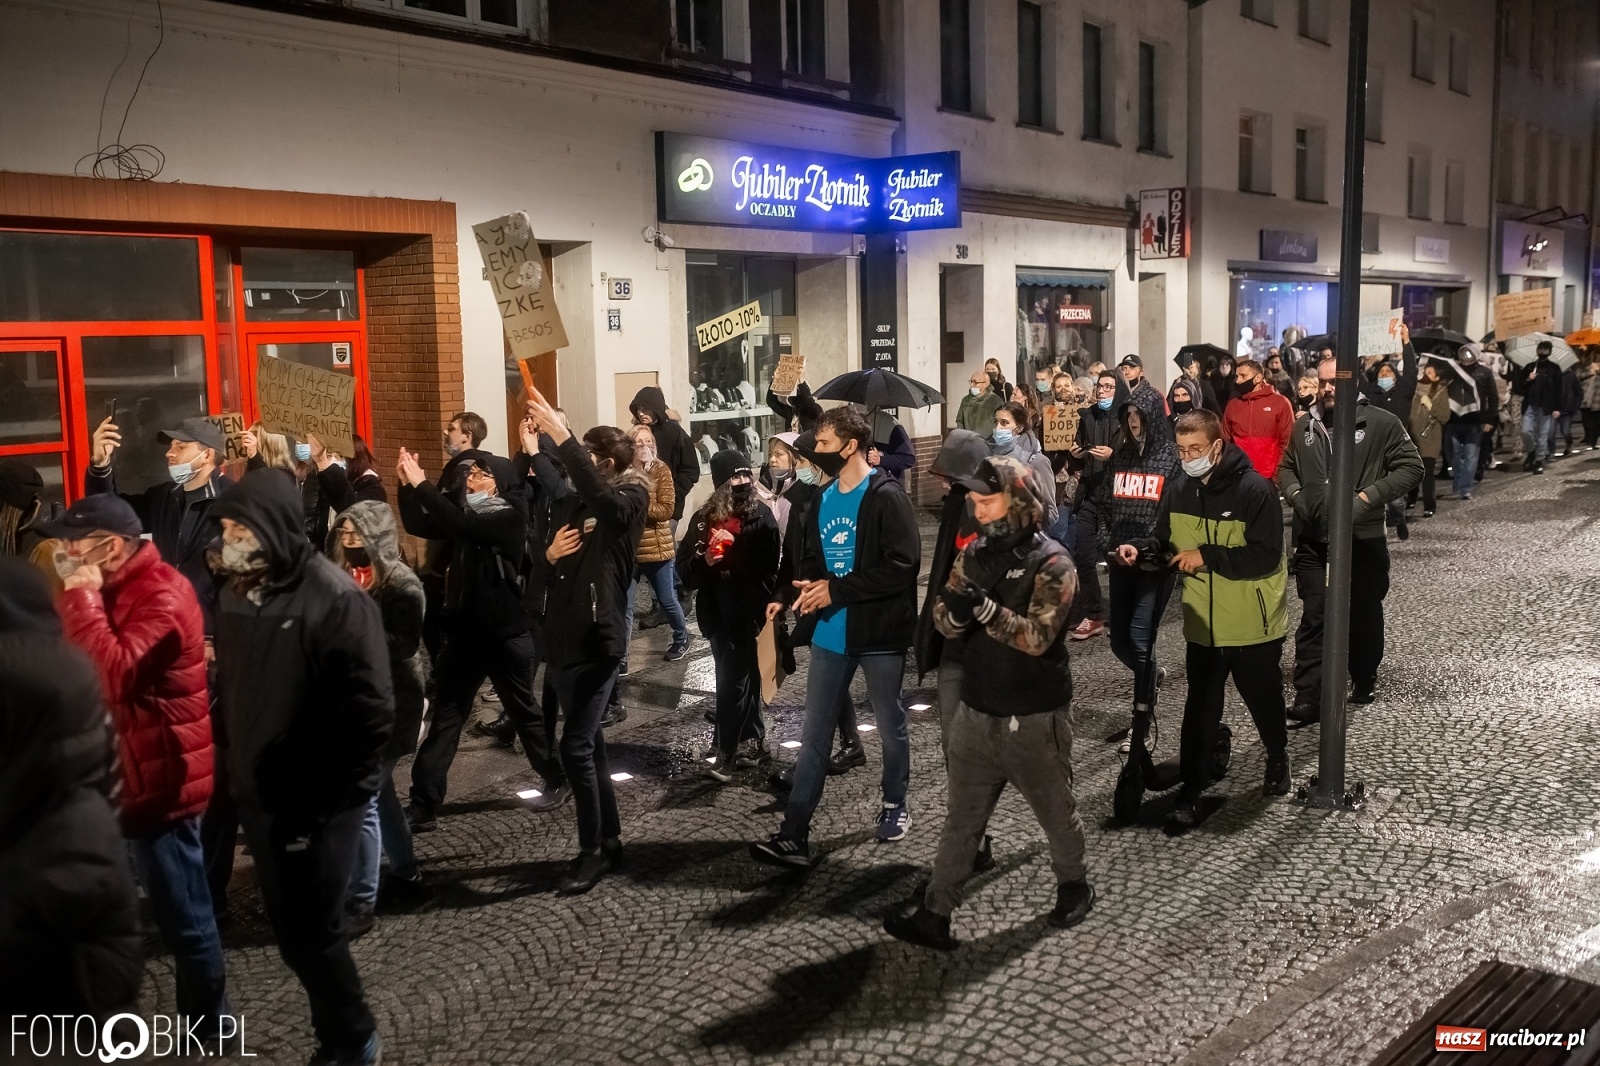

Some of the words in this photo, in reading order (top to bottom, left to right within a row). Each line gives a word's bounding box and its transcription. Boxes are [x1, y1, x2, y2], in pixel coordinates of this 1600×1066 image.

[731, 156, 804, 211] Jubiler
[805, 164, 870, 211] Złotnik
[888, 169, 943, 197] Jubiler
[750, 202, 797, 218] OCZADŁY
[889, 198, 944, 222] Złotnik
[615, 282, 630, 295] 36
[610, 316, 619, 326] 36
[1060, 308, 1092, 320] PRZECENA
[699, 318, 733, 347] ZŁOTO
[735, 306, 760, 329] -10%
[258, 357, 292, 384] MOIM
[294, 366, 352, 401] CIAŁEM
[831, 531, 849, 545] 4F
